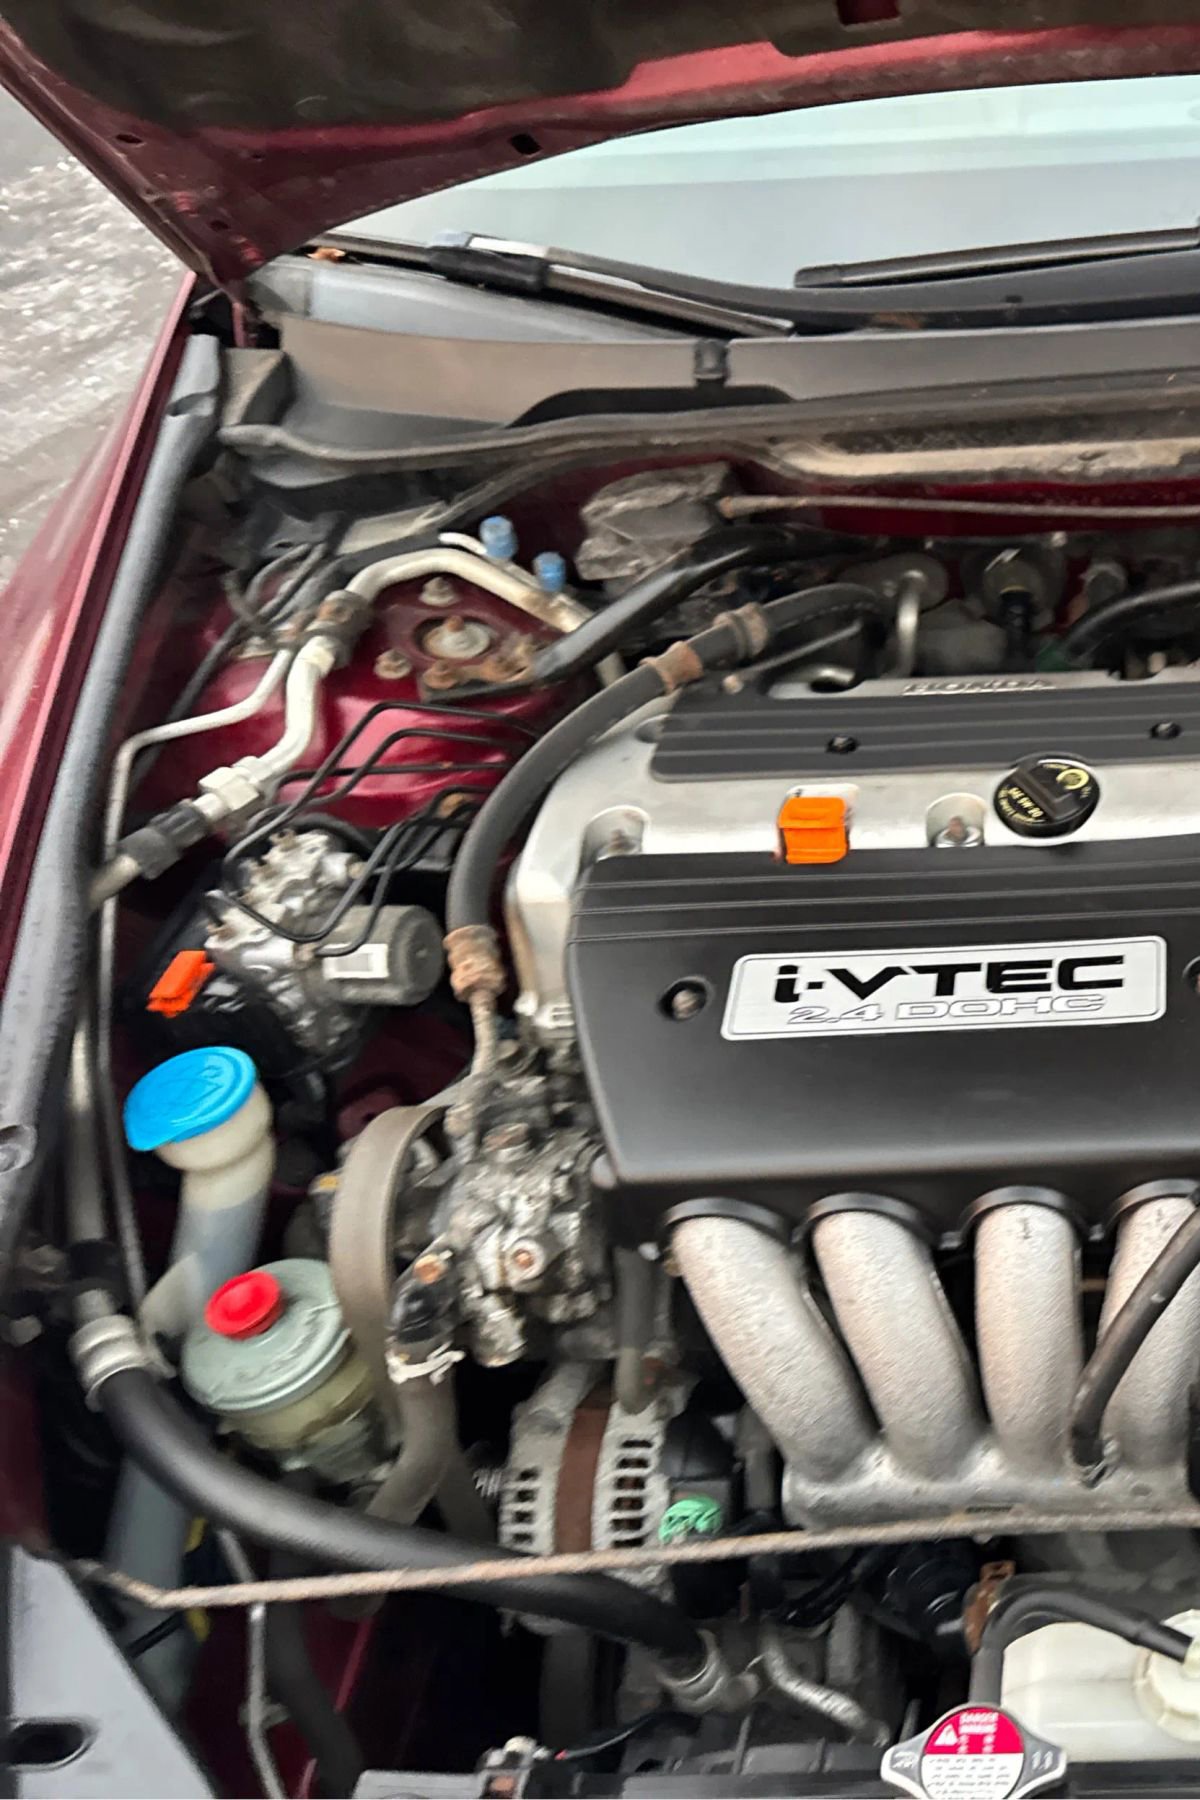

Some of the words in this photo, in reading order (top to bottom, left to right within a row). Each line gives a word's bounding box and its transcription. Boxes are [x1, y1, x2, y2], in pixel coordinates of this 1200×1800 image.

[902, 680, 1057, 696] HONDA
[774, 954, 1125, 1004] i-VTEC
[787, 1003, 883, 1025] 2.4
[896, 994, 1107, 1020] DOHC
